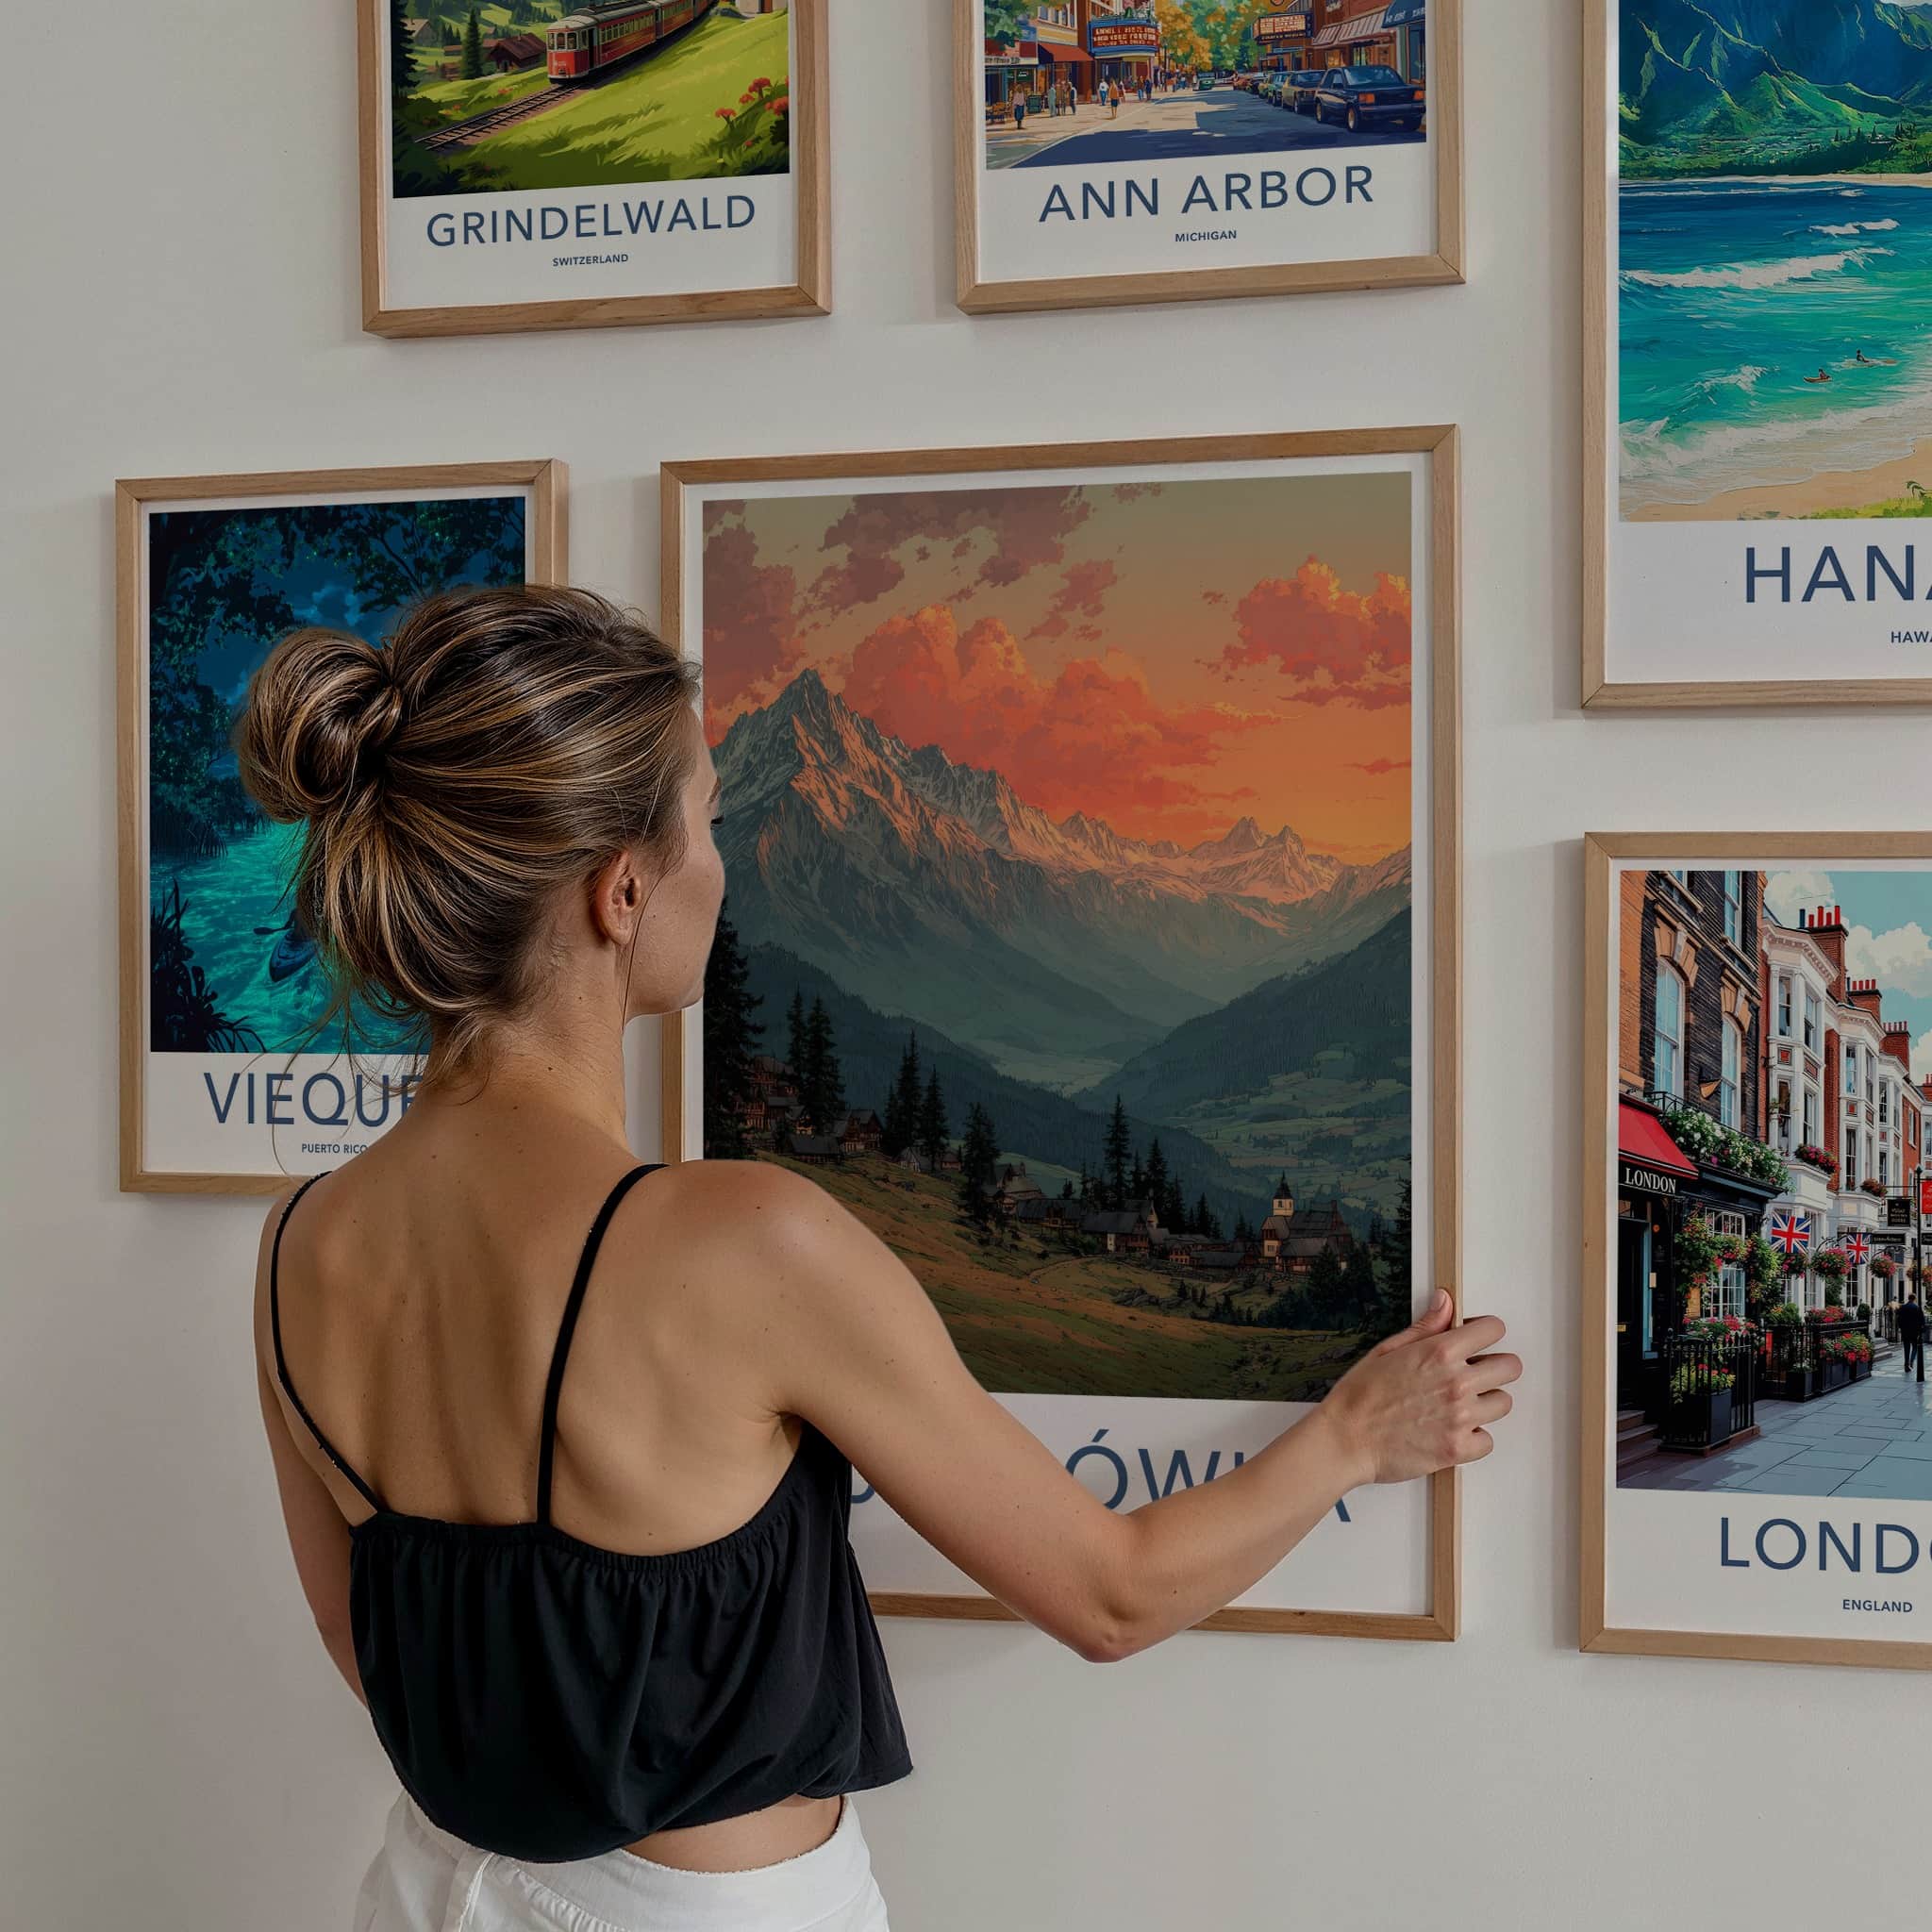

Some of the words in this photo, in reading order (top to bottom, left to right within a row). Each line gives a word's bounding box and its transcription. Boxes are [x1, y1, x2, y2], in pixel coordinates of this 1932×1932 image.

[1039, 177, 1159, 223] ANN
[1181, 165, 1374, 214] ARBOR
[426, 194, 756, 247] GRINDELWALD
[1174, 229, 1237, 242] MICHIGAN
[552, 254, 629, 267] SWITZERLAND
[1745, 544, 1932, 603] HAN
[1890, 630, 1932, 643] HAW
[301, 1143, 341, 1154] PUERTO
[1625, 1167, 1676, 1194] LONDON
[1721, 1516, 1932, 1574] LOND
[1842, 1599, 1913, 1613] ENGLAND
